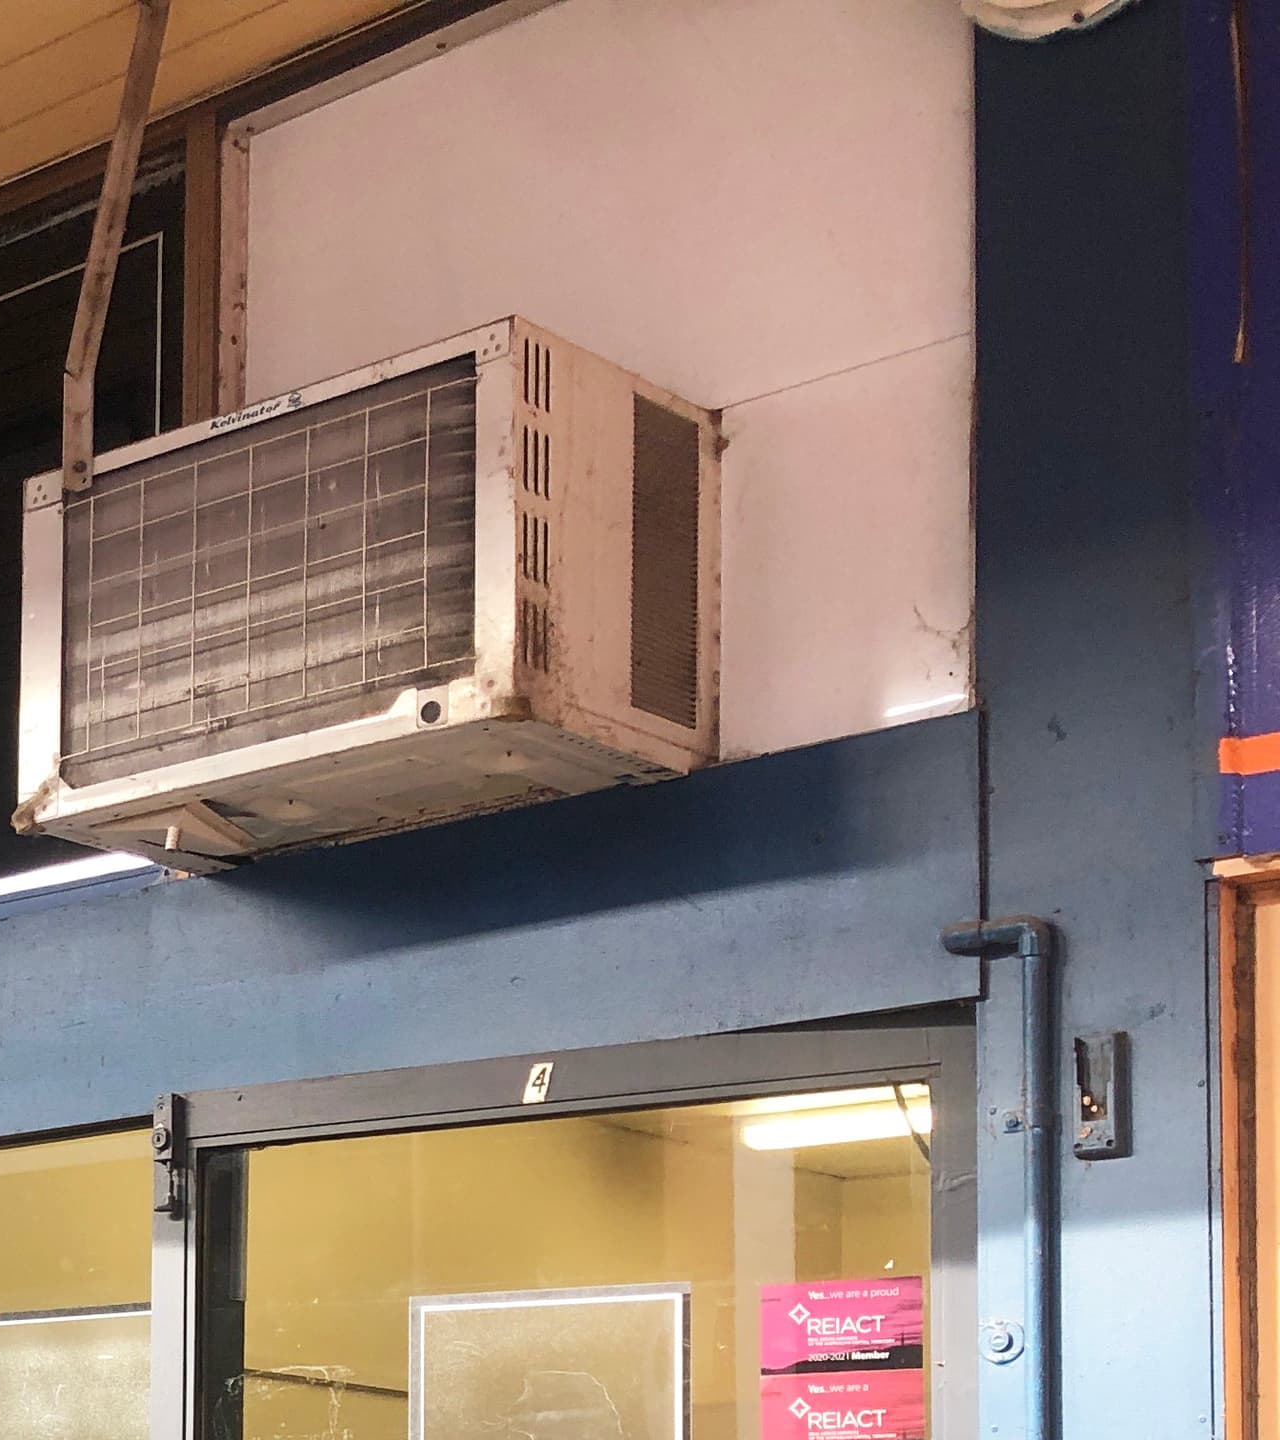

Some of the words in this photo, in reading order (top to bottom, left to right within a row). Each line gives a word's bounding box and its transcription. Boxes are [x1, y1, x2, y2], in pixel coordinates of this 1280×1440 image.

[209, 401, 281, 430] Kelvinator
[531, 1066, 548, 1093] 4
[845, 1290, 861, 1298] are
[870, 1287, 900, 1299] proud
[807, 1314, 886, 1336] REIACT
[807, 1351, 849, 1362] 2020-2021
[851, 1350, 891, 1361] Member
[846, 1384, 861, 1392] are
[807, 1408, 887, 1430] REIACT
